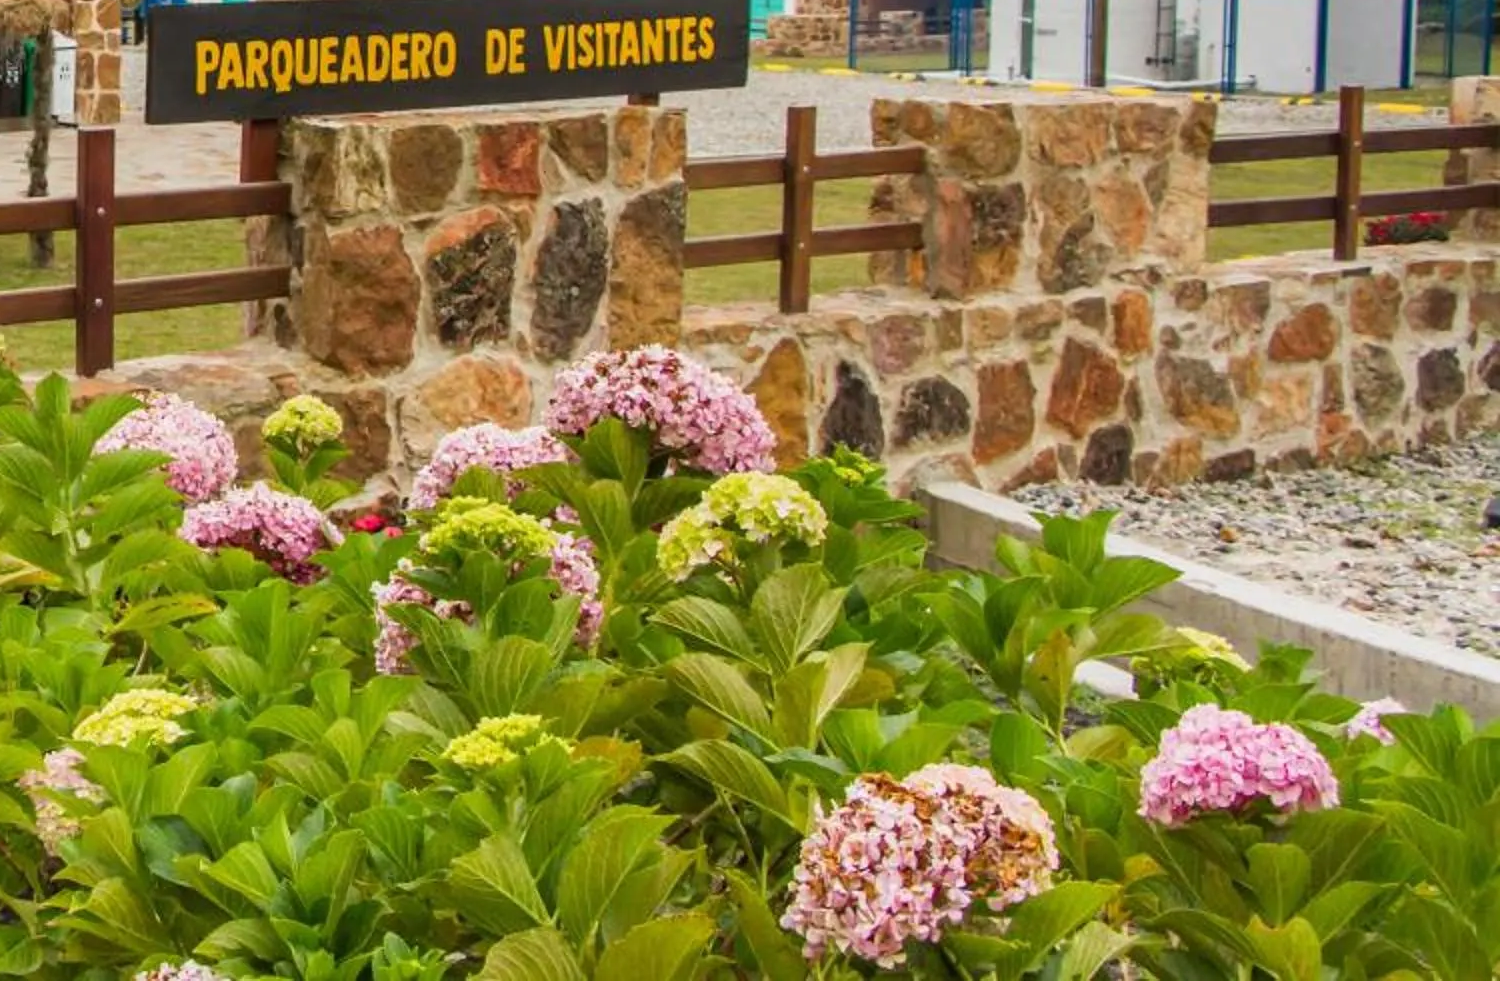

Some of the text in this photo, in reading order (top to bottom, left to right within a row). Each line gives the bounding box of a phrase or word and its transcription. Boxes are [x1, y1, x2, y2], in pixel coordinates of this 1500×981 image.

[195, 16, 715, 95] PARQUEADERO DE VISITANTES
